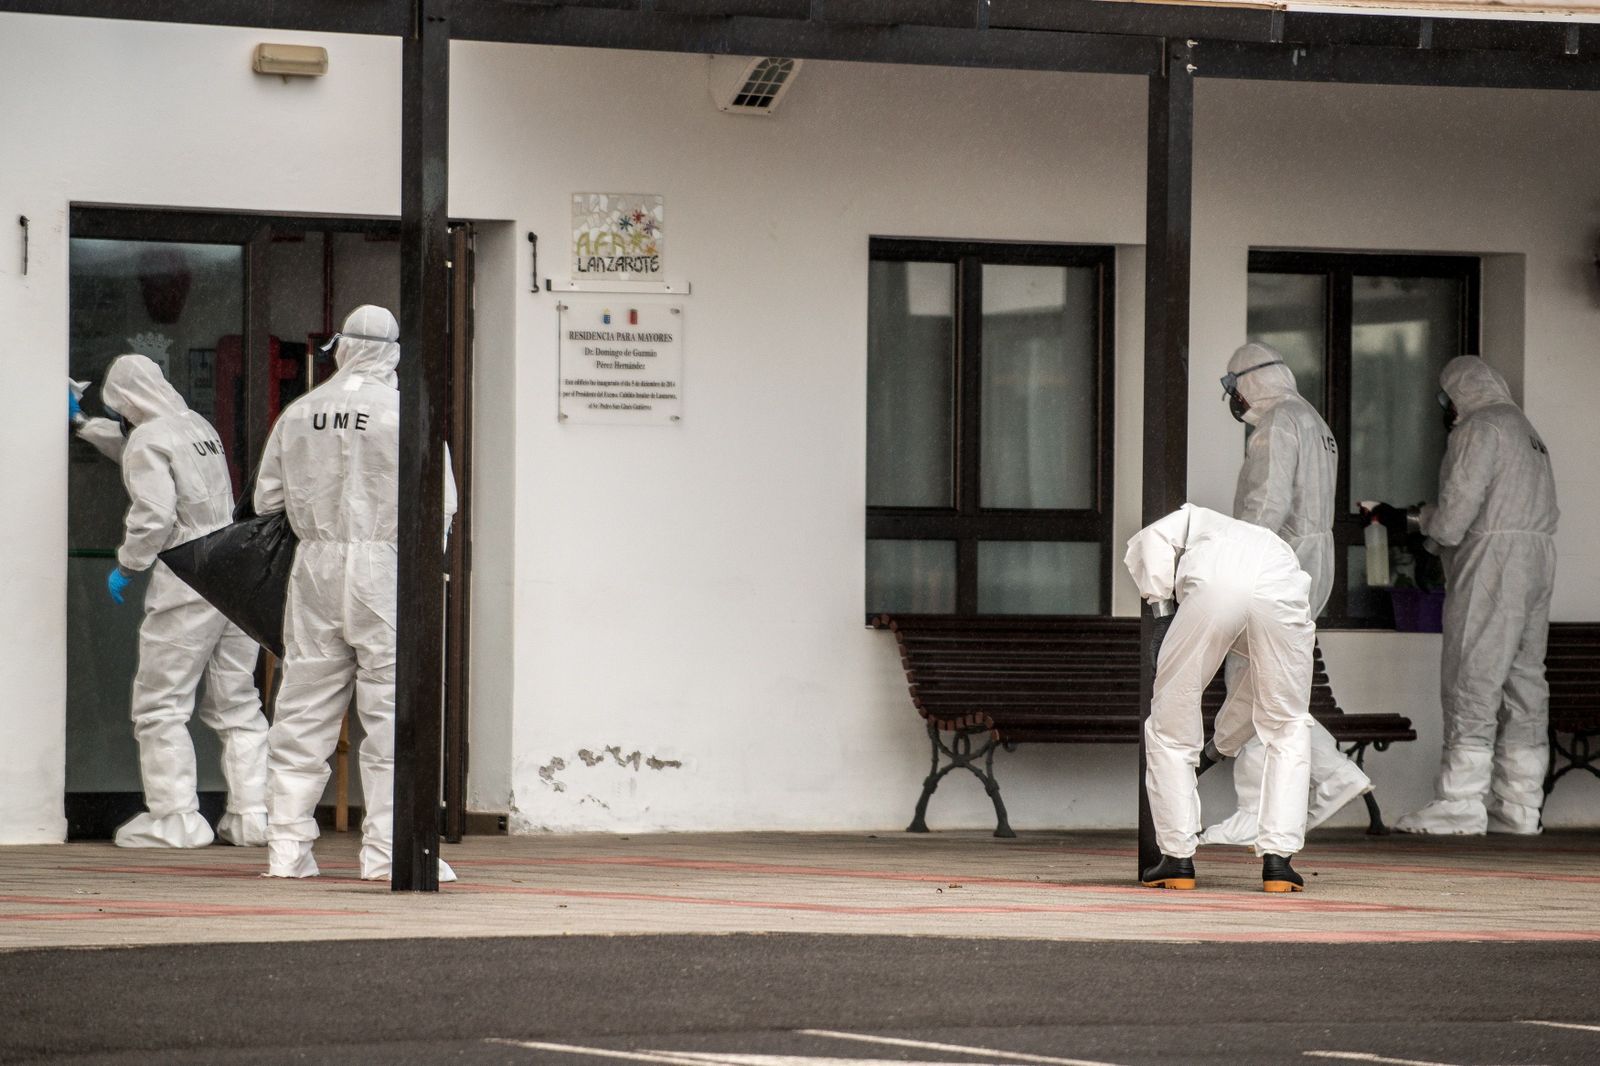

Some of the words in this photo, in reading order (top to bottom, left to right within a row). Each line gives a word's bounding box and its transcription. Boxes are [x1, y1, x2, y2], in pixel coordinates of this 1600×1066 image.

[577, 255, 660, 273] LANZAROTE
[569, 331, 614, 341] RESIDENCIA
[616, 332, 635, 342] PARA
[637, 333, 673, 343] MAYORES
[595, 347, 622, 359] Domingo
[624, 349, 632, 357] de
[614, 361, 645, 370] Hernández
[313, 412, 370, 431] UME
